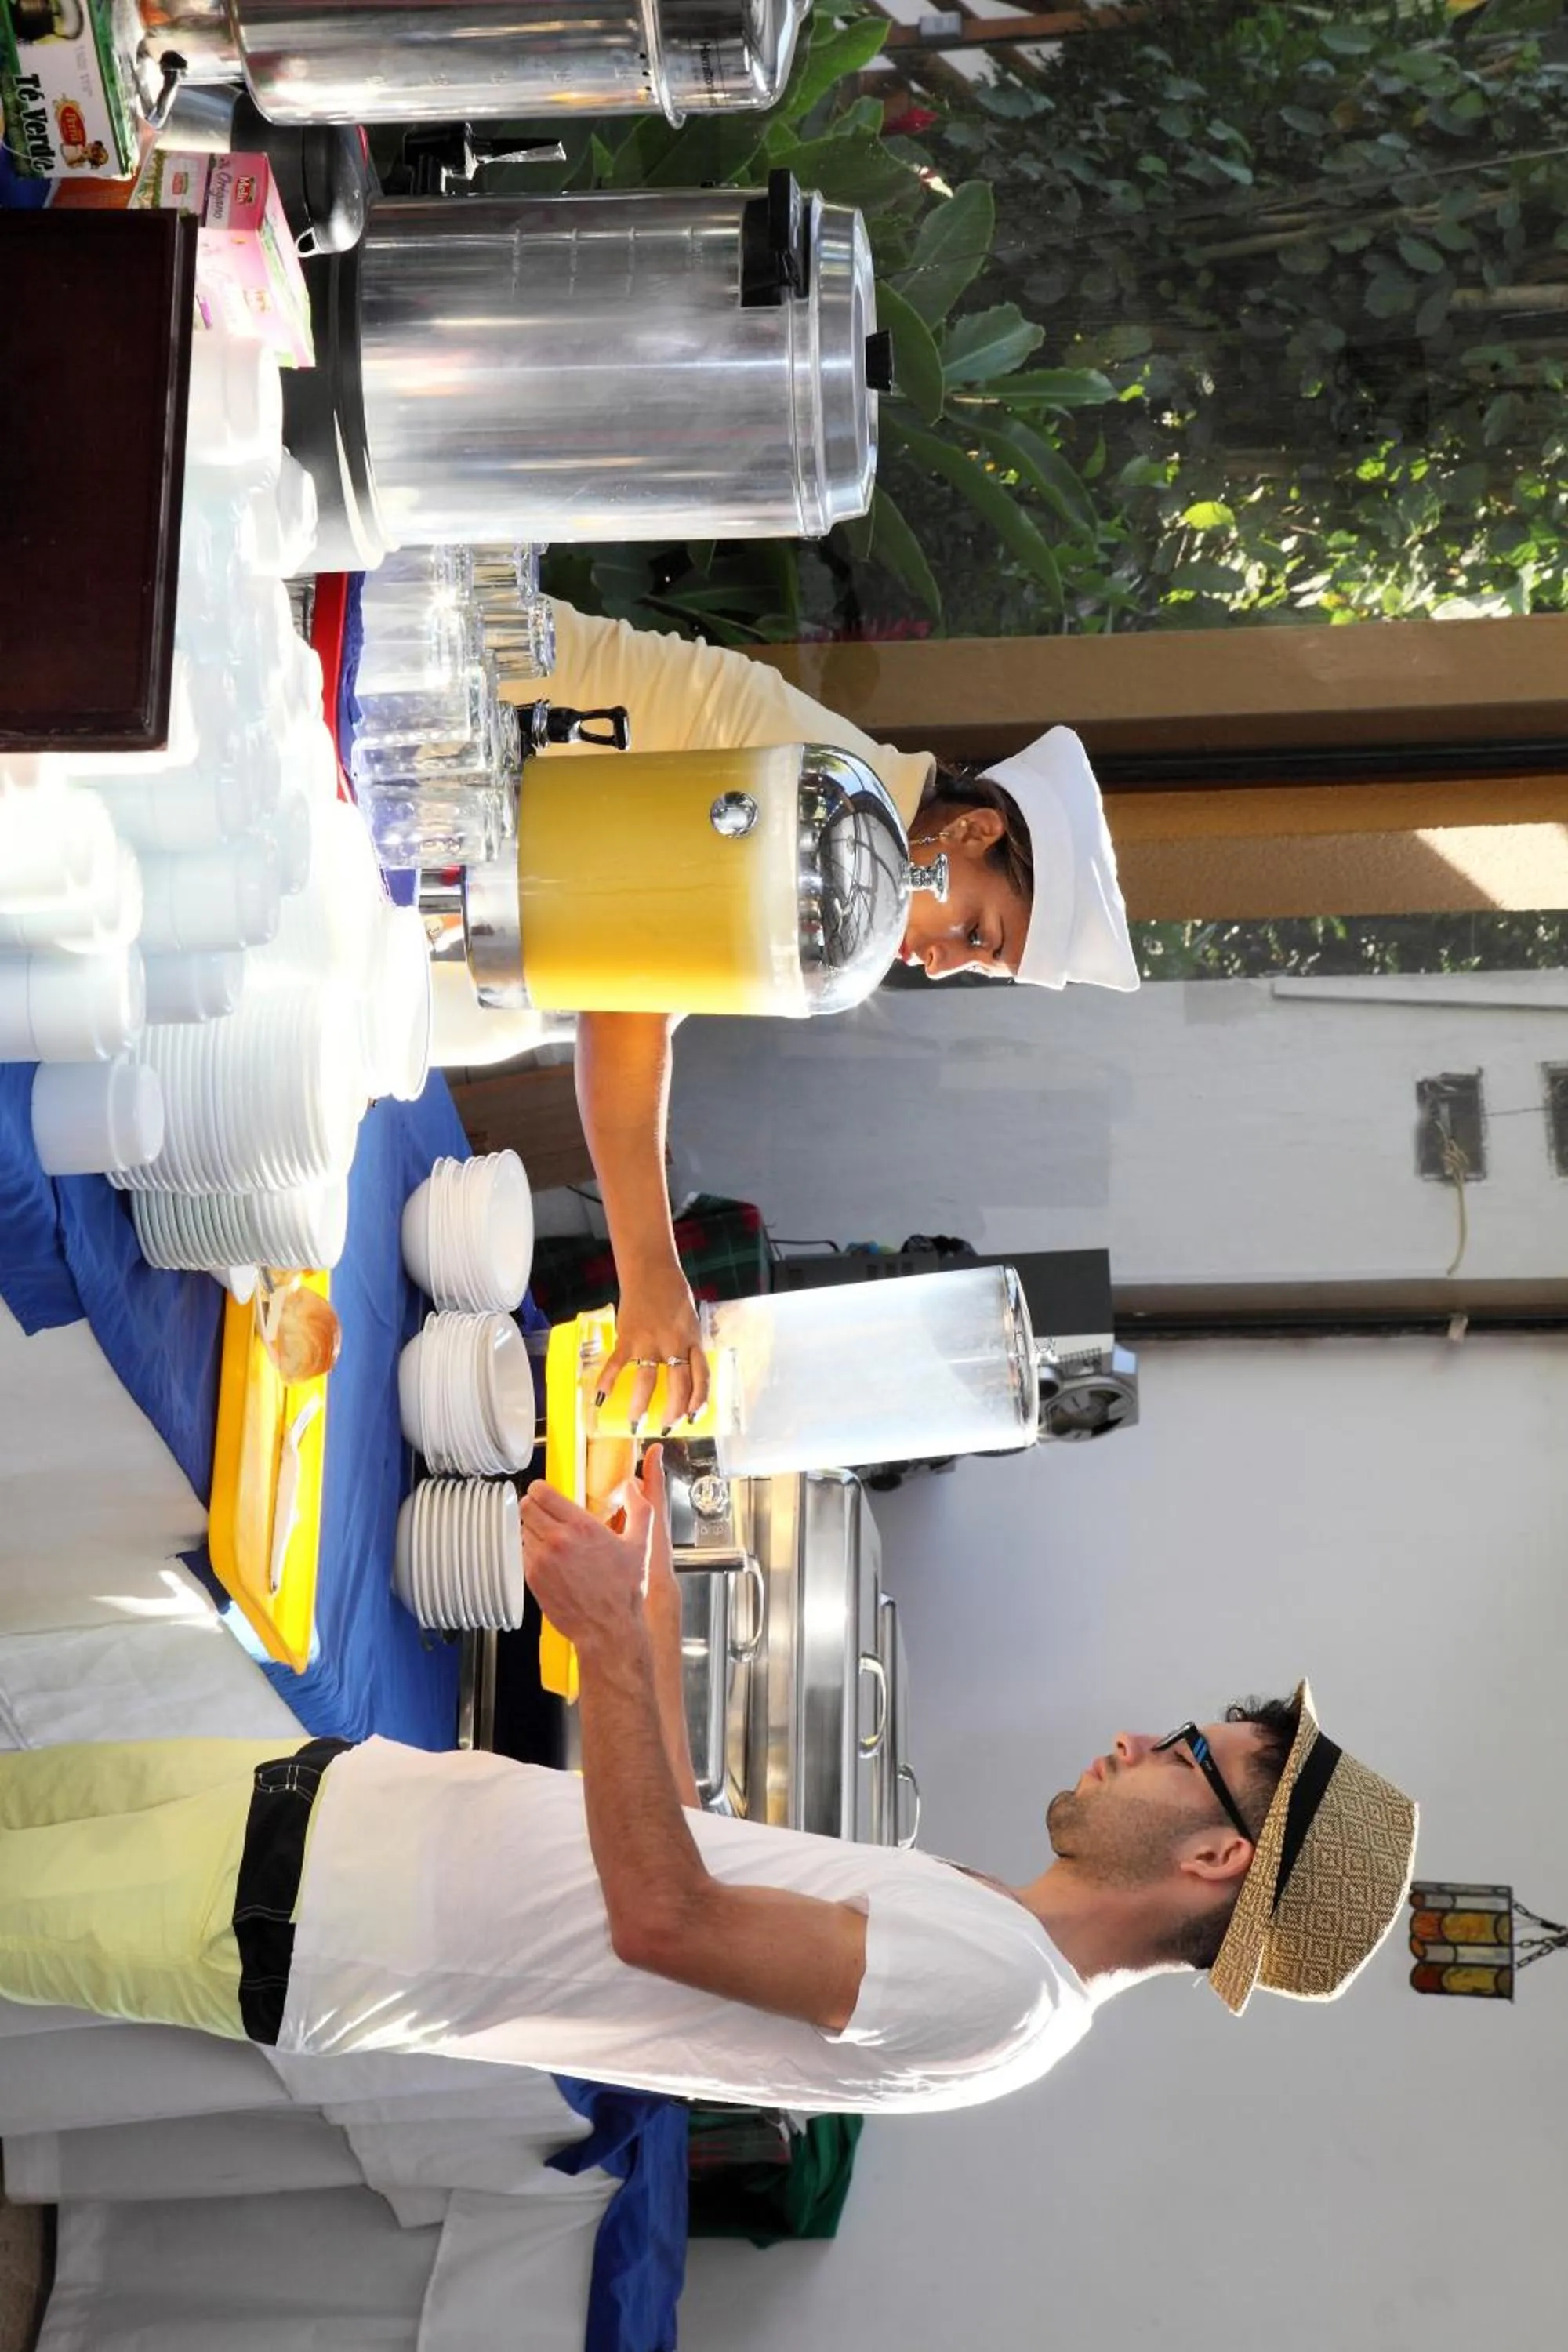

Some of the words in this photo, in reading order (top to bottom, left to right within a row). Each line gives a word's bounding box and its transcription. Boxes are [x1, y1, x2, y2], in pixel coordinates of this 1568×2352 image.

[15, 74, 45, 103] Té
[21, 108, 56, 170] Verde
[208, 172, 232, 219] Orégano
